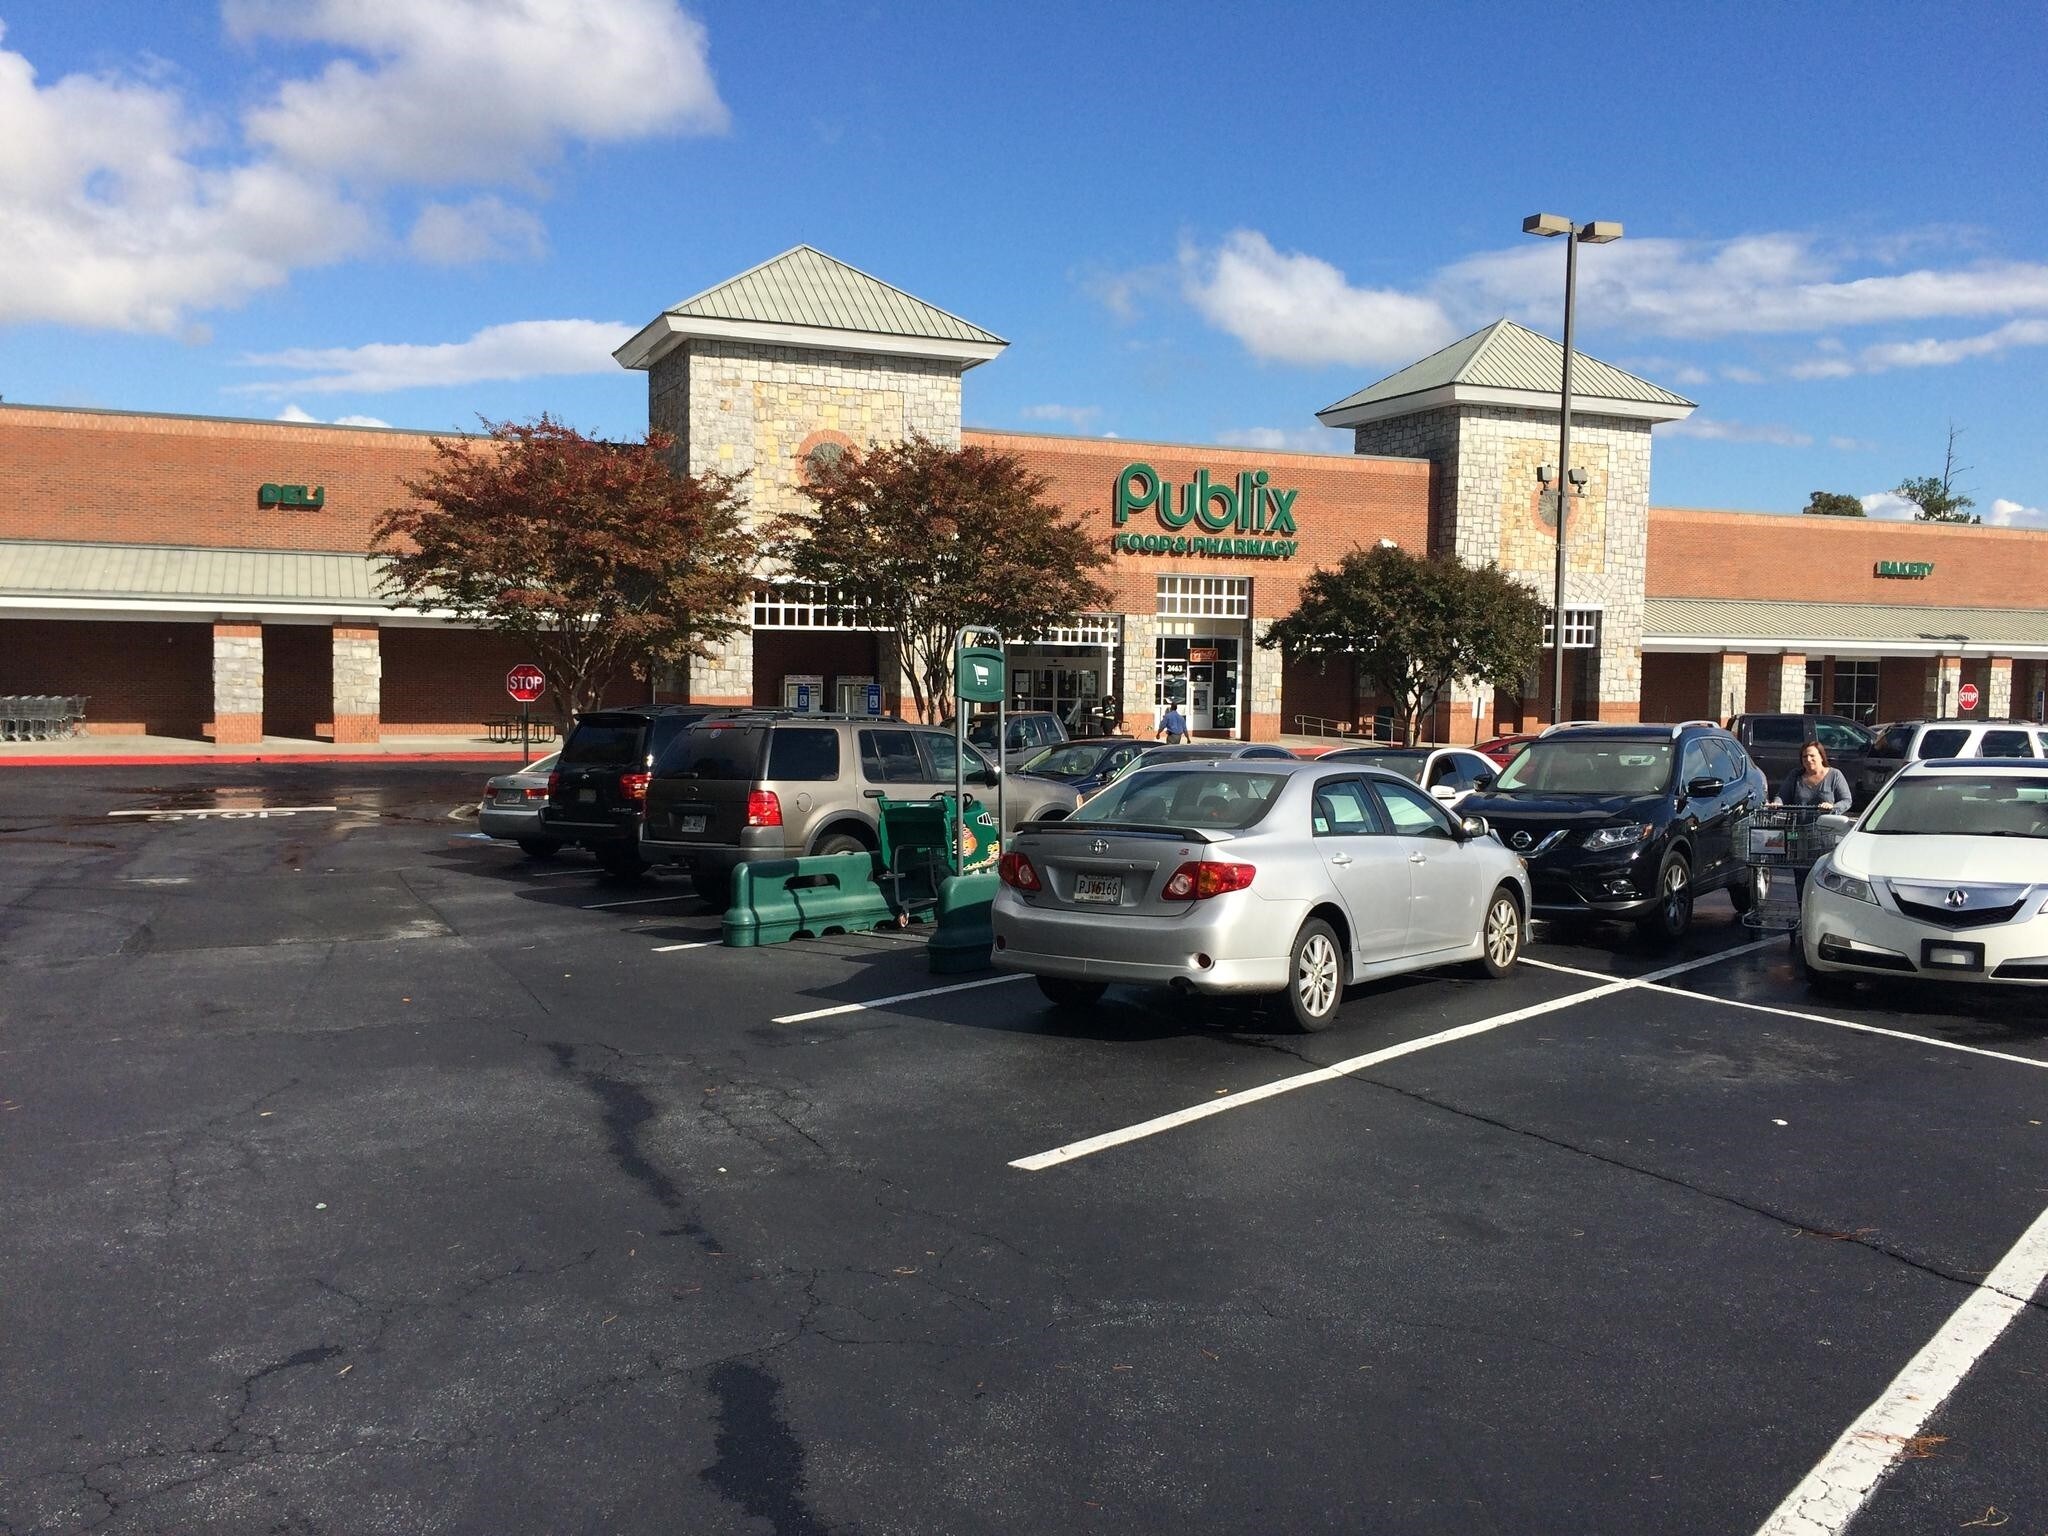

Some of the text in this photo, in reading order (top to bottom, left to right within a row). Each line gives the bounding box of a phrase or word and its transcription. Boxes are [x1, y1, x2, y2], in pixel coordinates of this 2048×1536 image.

[262, 483, 324, 505] DELI
[1116, 463, 1298, 532] Publix
[1115, 533, 1172, 551] FOOD
[1191, 537, 1298, 556] PHARMACY
[1877, 561, 1935, 576] BAKERY
[510, 676, 543, 690] STOP
[1960, 692, 1978, 702] STOP
[147, 811, 297, 822] STOP
